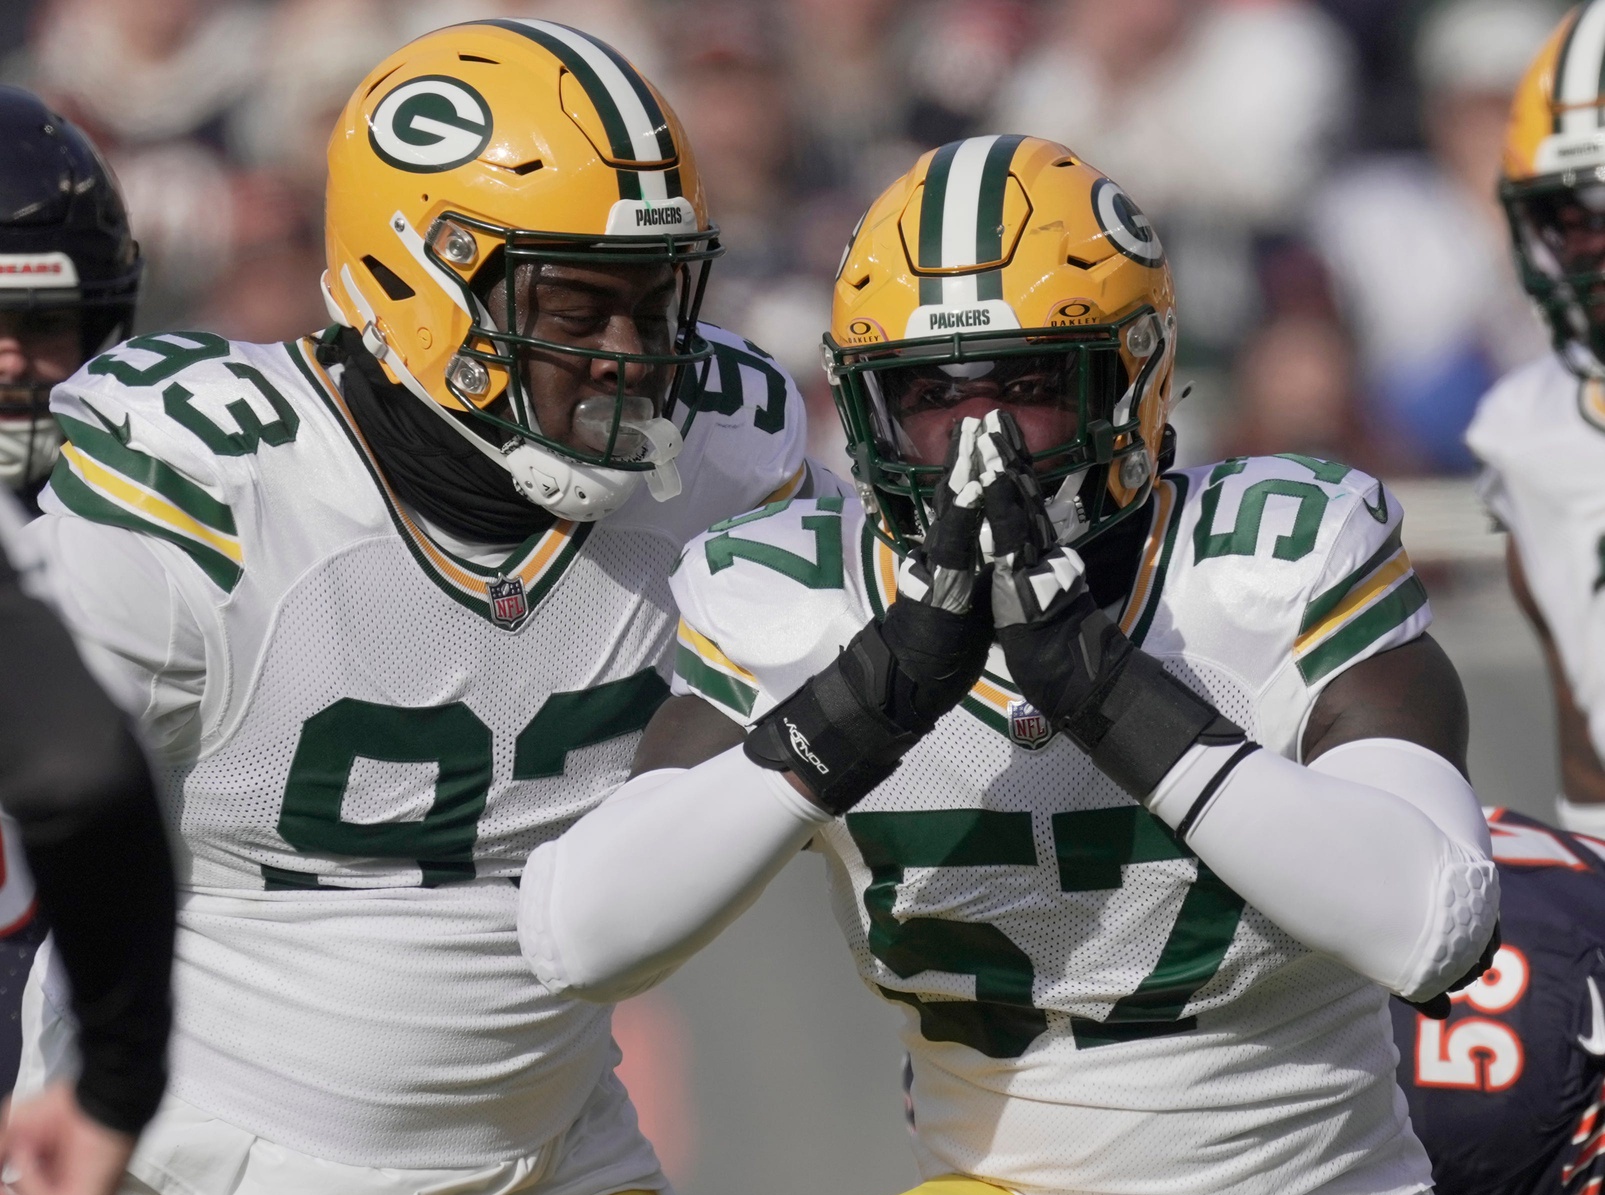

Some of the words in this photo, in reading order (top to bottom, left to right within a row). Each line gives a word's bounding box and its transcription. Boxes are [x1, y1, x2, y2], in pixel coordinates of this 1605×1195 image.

[371, 77, 490, 170] G
[635, 207, 682, 227] PACKERS
[0, 263, 62, 274] EARS
[929, 308, 991, 330] PACKERS
[1051, 317, 1098, 327] OAKLEY
[847, 335, 880, 344] OAKLEY
[88, 331, 300, 457] 93
[495, 597, 524, 619] NFL
[1015, 716, 1045, 739] NFL
[845, 804, 1246, 1059] 57
[1414, 943, 1531, 1093] 58
